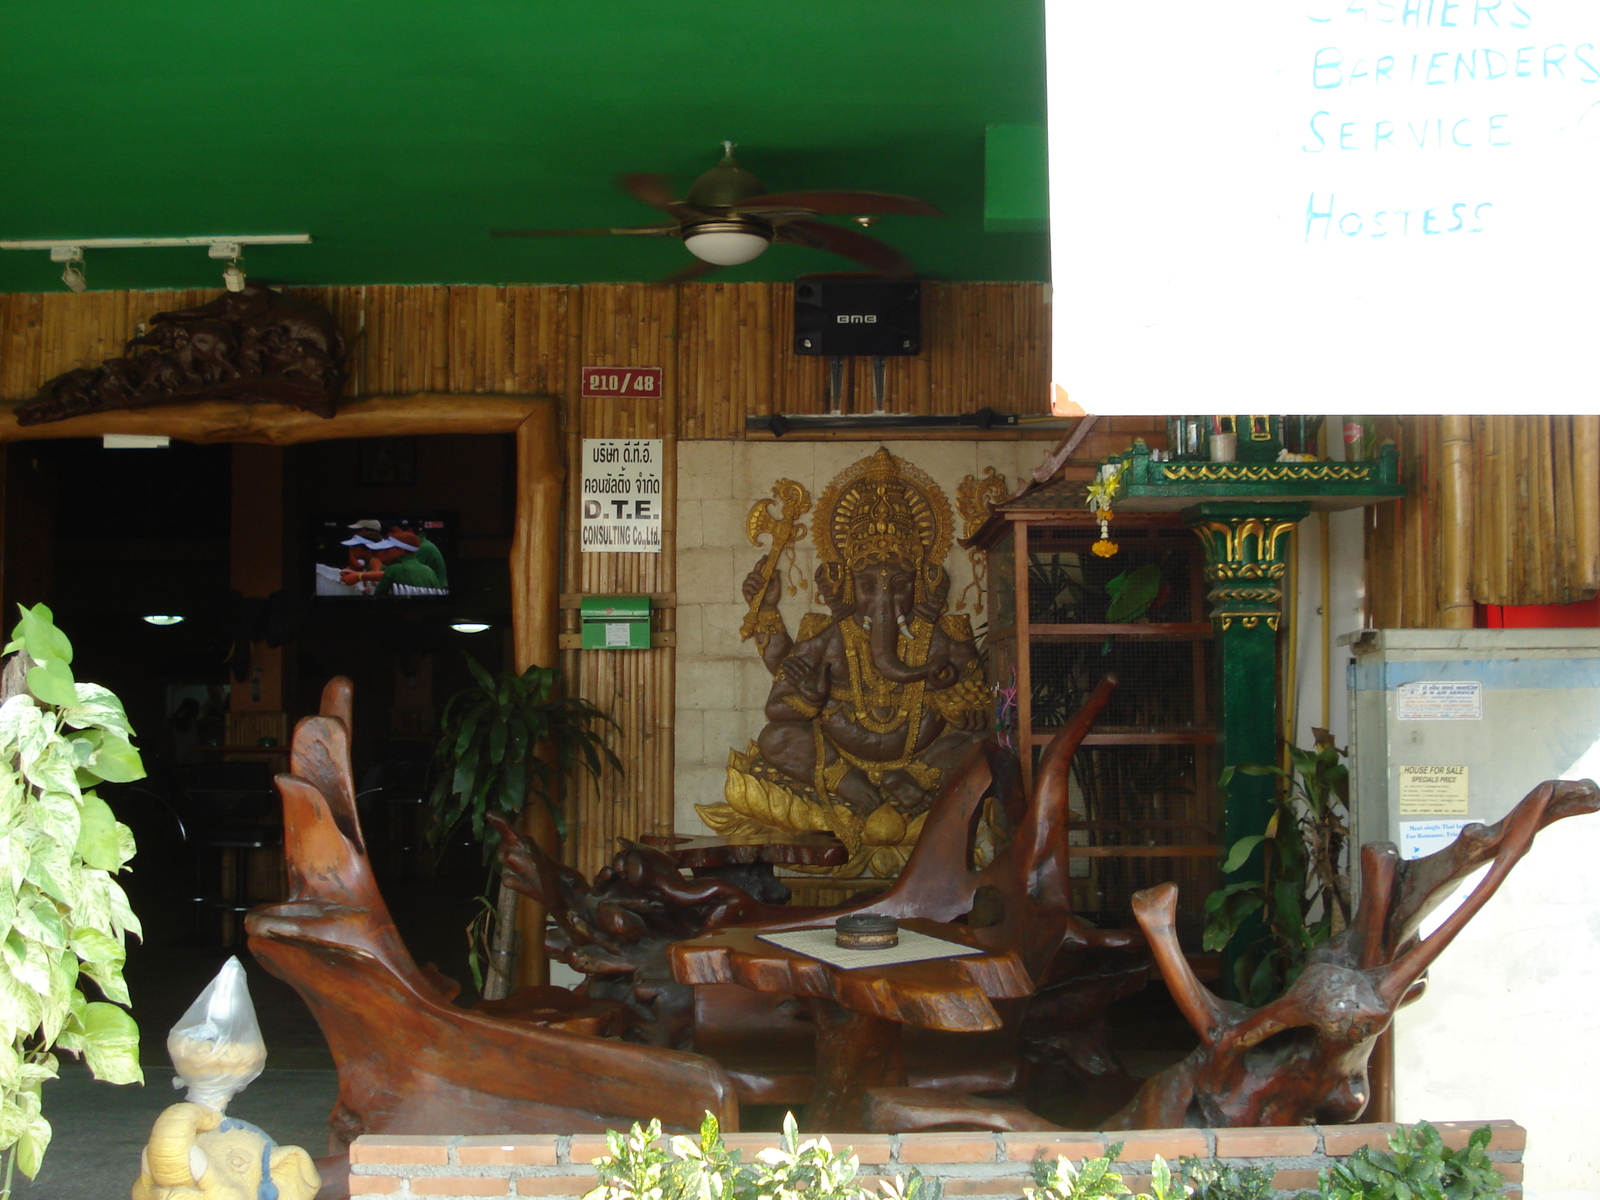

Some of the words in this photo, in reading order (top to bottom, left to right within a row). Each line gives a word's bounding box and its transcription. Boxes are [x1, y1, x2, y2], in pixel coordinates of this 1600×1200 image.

[1306, 0, 1531, 29] ASHIERS
[1313, 43, 1600, 90] BARTENDERS
[1302, 110, 1512, 153] SERVICE
[1305, 192, 1494, 243] HOSTESS
[589, 373, 654, 393] 210/48
[592, 442, 619, 463] บริษัท
[635, 472, 660, 494] จำกัด
[584, 500, 659, 520] D.T.E.
[583, 525, 631, 545] CONSULTING
[1404, 766, 1428, 774] HOUSE
[1429, 766, 1445, 774] FOR
[1446, 766, 1464, 775] SALE
